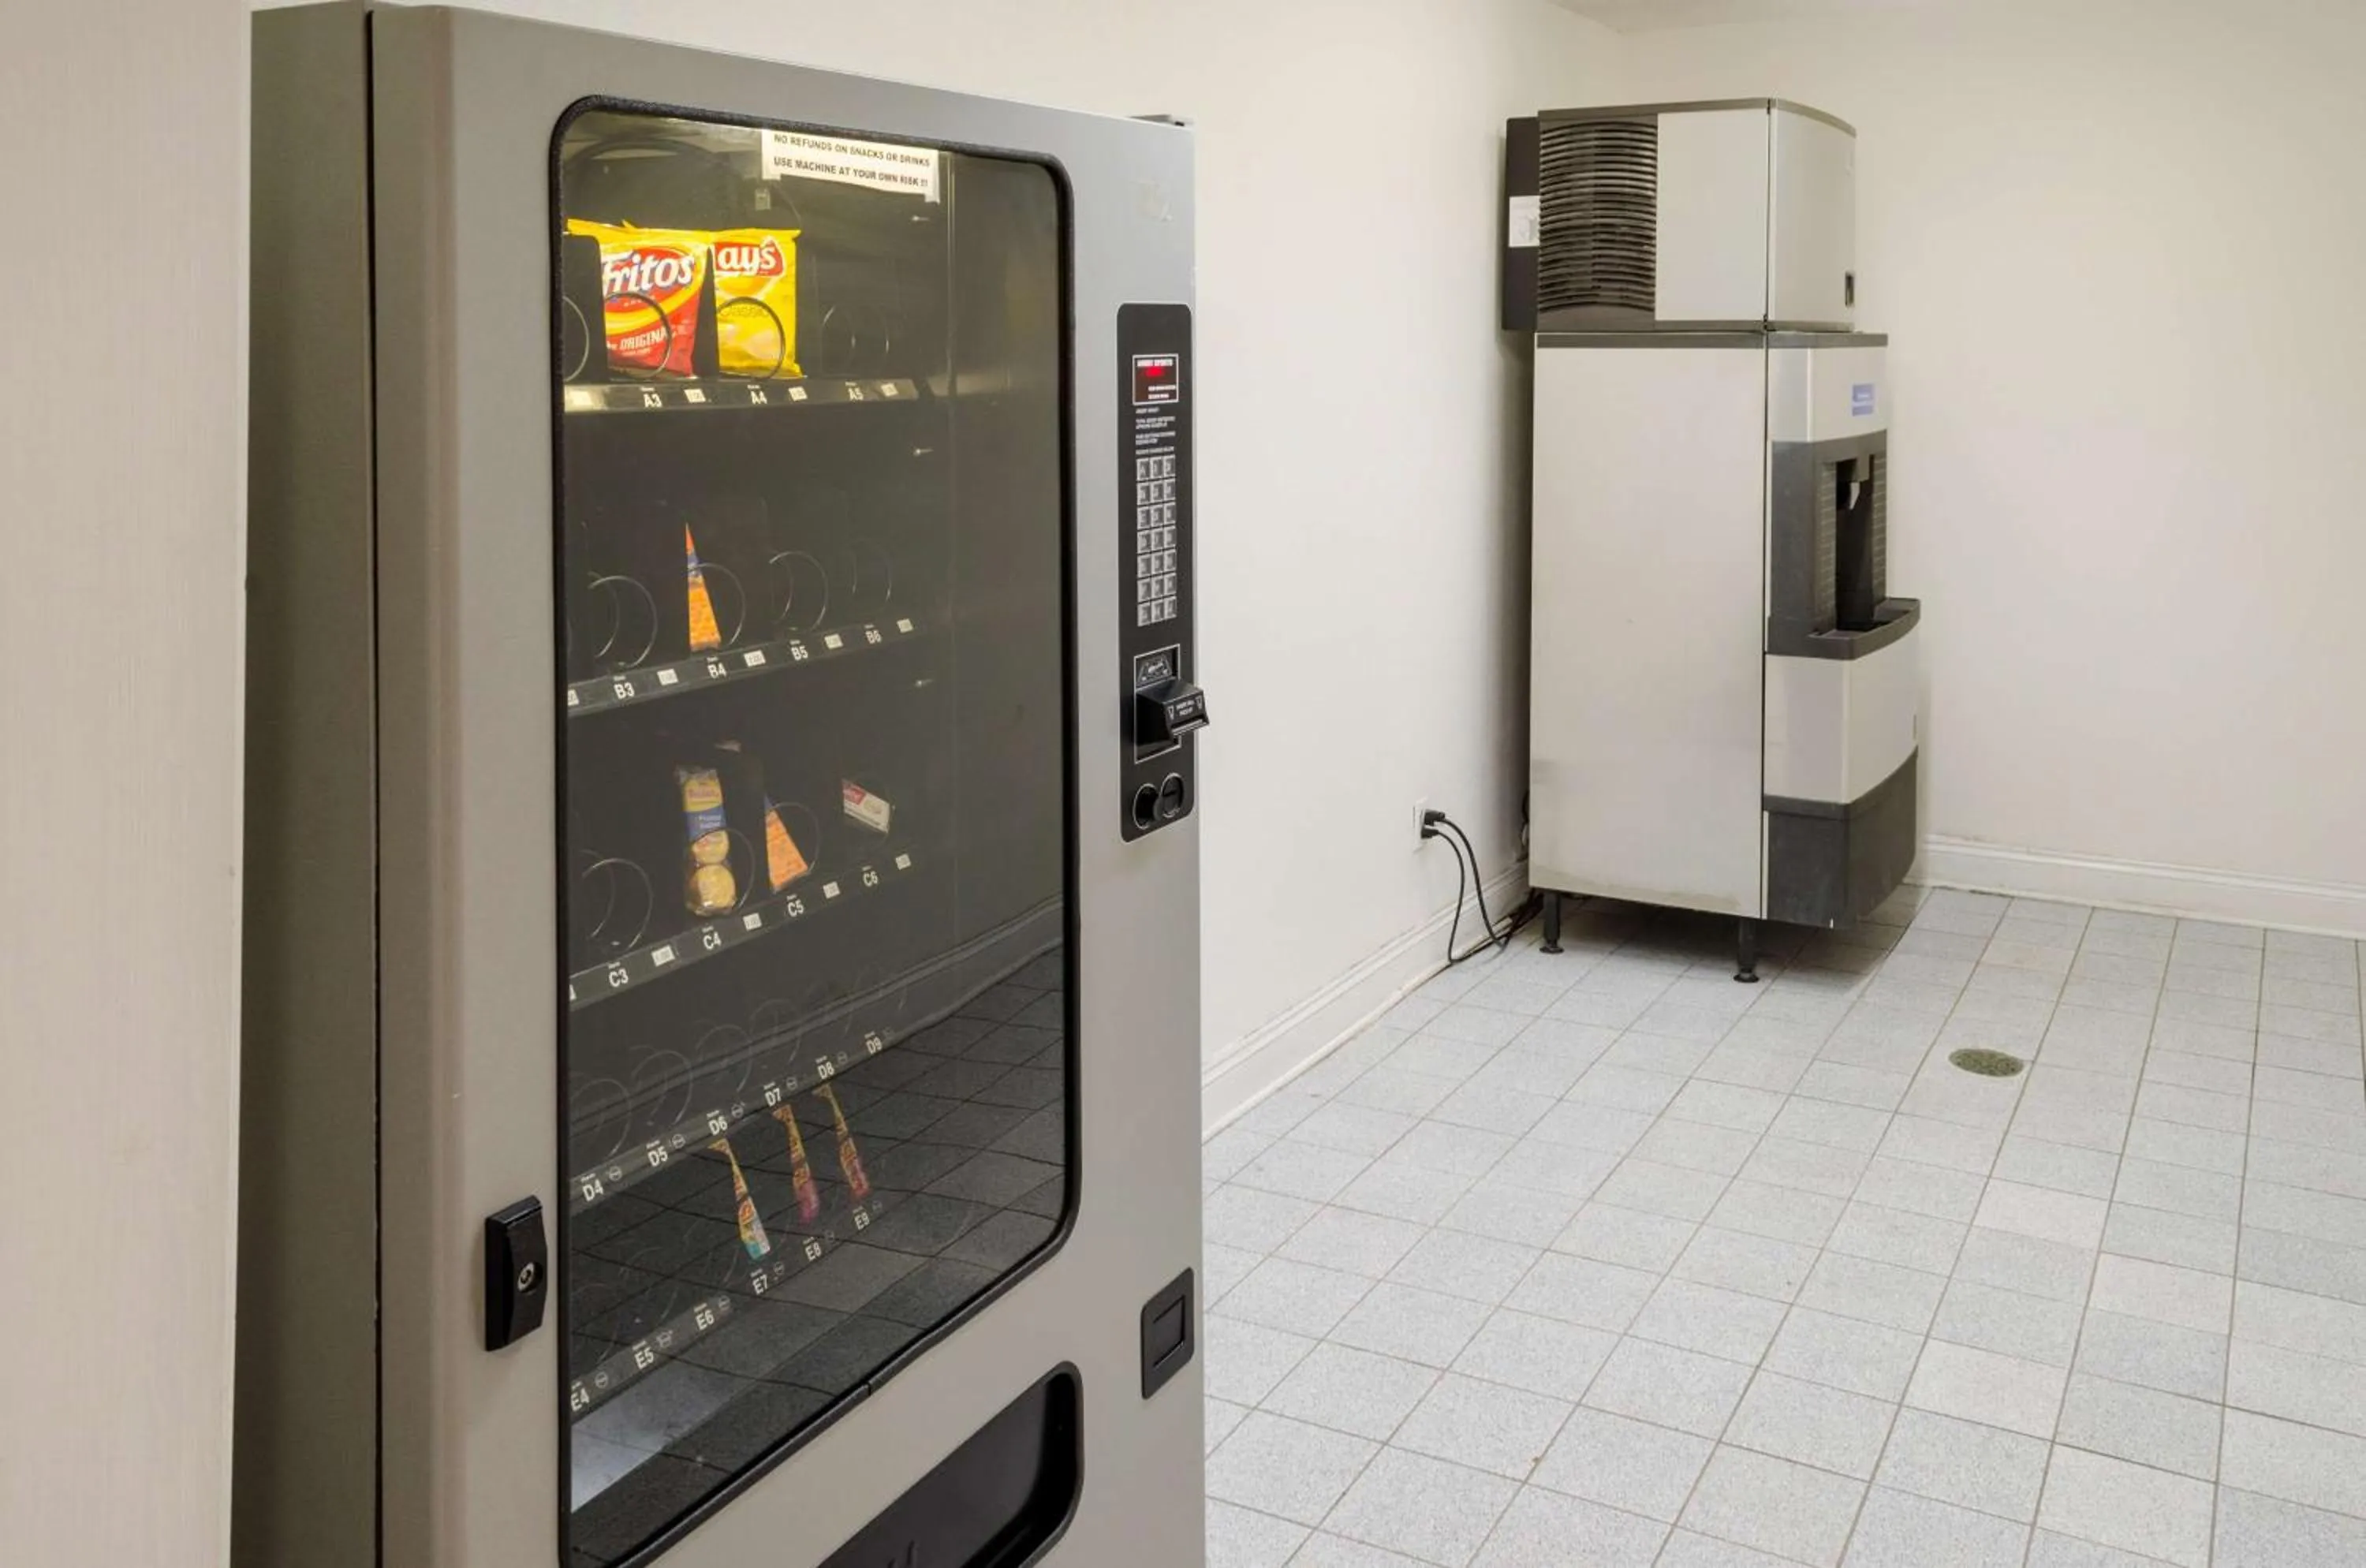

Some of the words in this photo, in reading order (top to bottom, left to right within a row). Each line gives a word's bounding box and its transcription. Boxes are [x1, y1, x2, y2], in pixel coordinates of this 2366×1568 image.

[773, 133, 788, 145] NO
[790, 136, 832, 151] REFUNDS
[835, 144, 848, 155] ON
[849, 146, 884, 159] SNACKS
[886, 151, 898, 162] OR
[900, 154, 931, 167] DRINKS
[774, 156, 793, 168] USE
[794, 159, 837, 174] MACHINE
[838, 165, 851, 176] AT
[853, 168, 876, 180] YOUR
[878, 171, 898, 183] OWN
[900, 174, 920, 187] RISK
[718, 239, 777, 275] ay's
[602, 251, 695, 296] Fritos
[644, 394, 662, 407] A3
[751, 390, 767, 404] A4
[848, 387, 864, 401] A5
[865, 629, 881, 644] B6
[791, 645, 808, 661] B5
[707, 663, 727, 679] B4
[614, 681, 635, 699] B3
[863, 871, 879, 887] C6
[788, 899, 804, 917] C5
[703, 931, 722, 950] C4
[608, 969, 629, 988] C3
[866, 1038, 883, 1054] D9
[817, 1061, 835, 1080] D8
[764, 1088, 782, 1107] D7
[709, 1115, 729, 1135] D6
[647, 1146, 669, 1167] D5
[583, 1178, 604, 1202] D4
[854, 1211, 871, 1230] E9
[804, 1243, 823, 1263] E8
[751, 1275, 770, 1295] E7
[695, 1311, 715, 1331] E6
[634, 1348, 655, 1370] E5
[570, 1391, 591, 1412] E4
